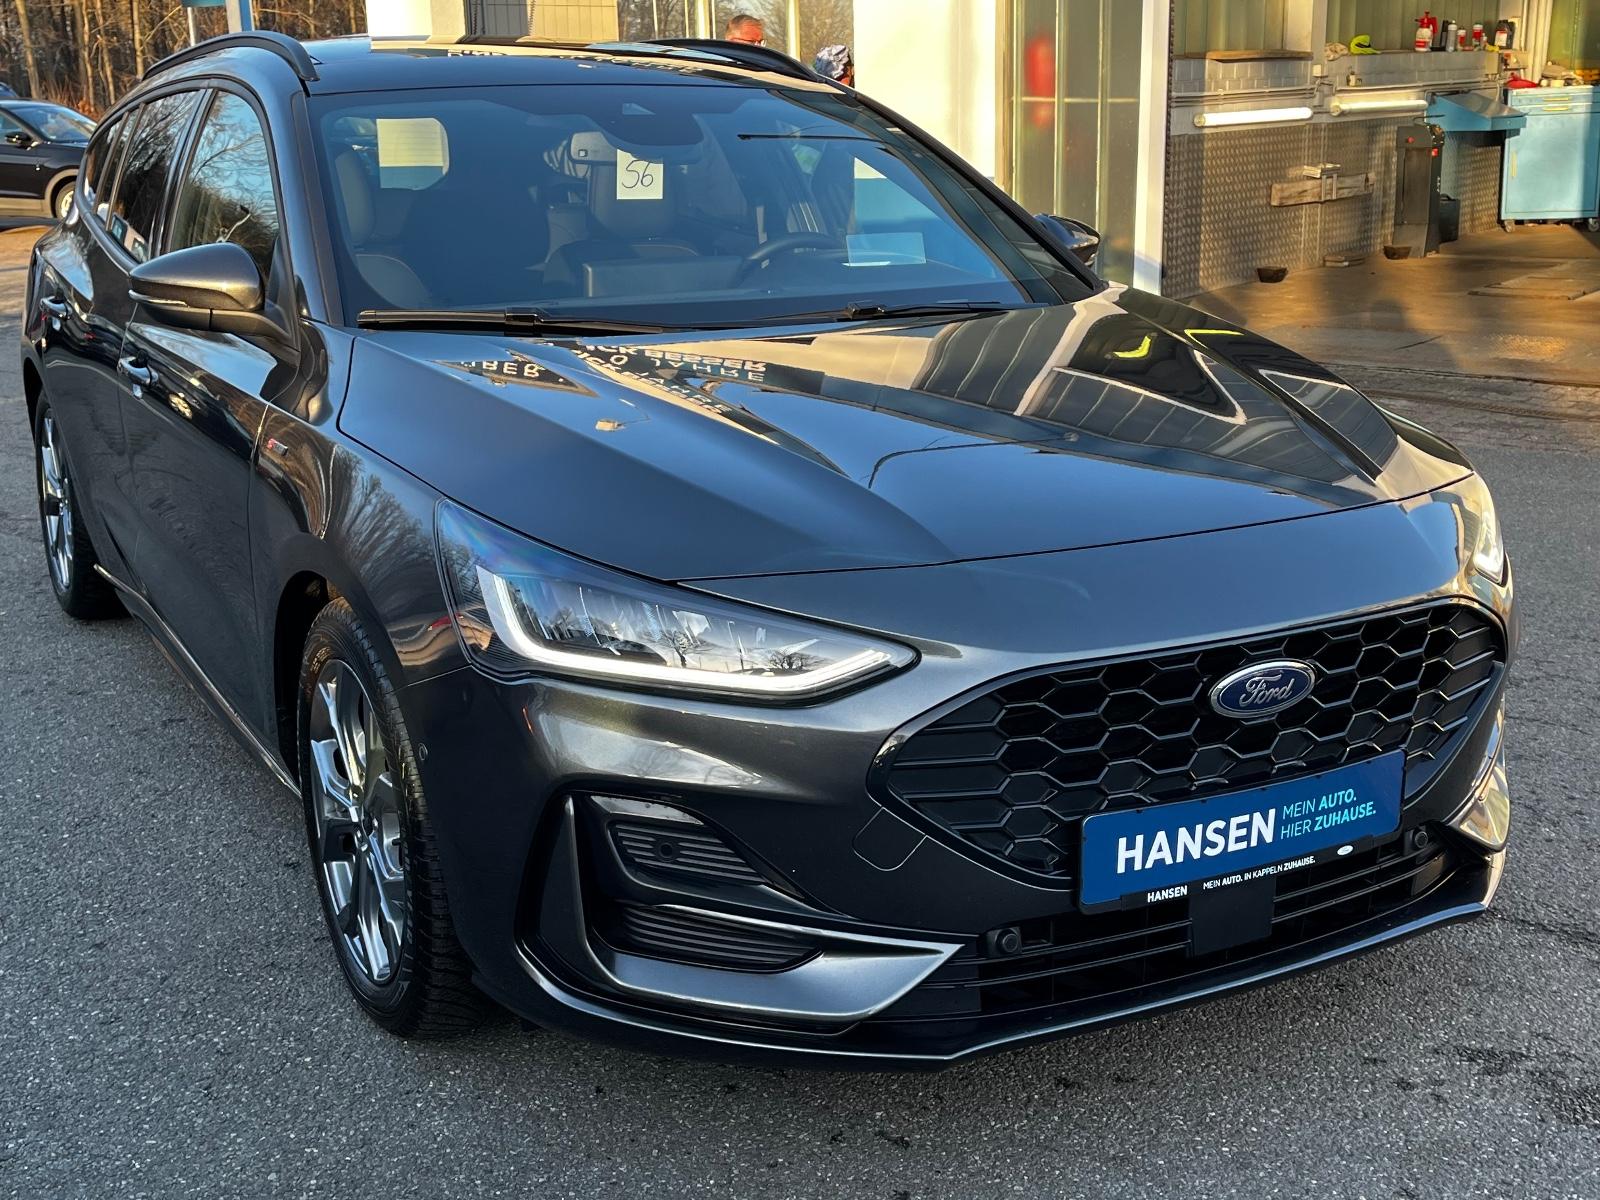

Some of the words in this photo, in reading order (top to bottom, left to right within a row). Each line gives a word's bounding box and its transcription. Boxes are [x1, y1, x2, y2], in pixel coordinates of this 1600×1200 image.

[621, 159, 654, 189] 56
[1239, 670, 1295, 707] Ford
[1280, 819, 1312, 840] HIER
[1313, 801, 1377, 832] ZUHAUSE.
[1282, 798, 1316, 820] MEIN
[1318, 788, 1357, 811] AUTO.
[1116, 808, 1276, 874] HANSEN
[1203, 879, 1221, 890] MEIN
[1221, 872, 1243, 886] AUTO.
[1243, 869, 1252, 881] IN
[1252, 863, 1283, 879] KAPPELN
[1283, 855, 1316, 872] ZUHAUSE.
[1147, 885, 1188, 903] HANSEN
